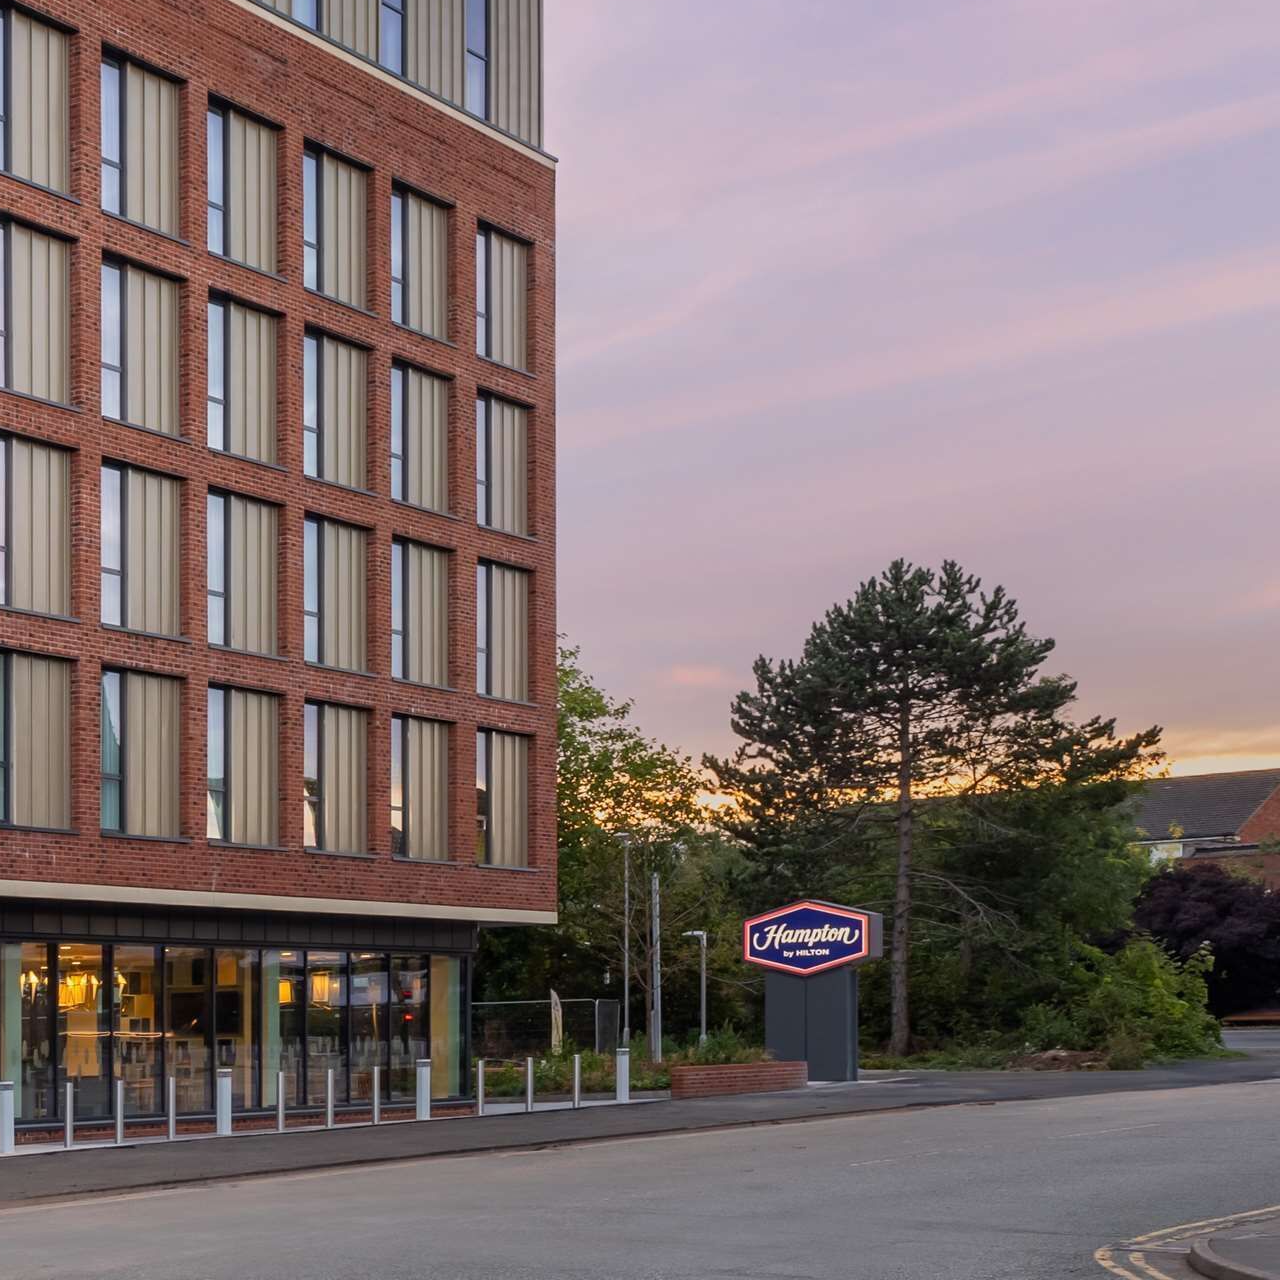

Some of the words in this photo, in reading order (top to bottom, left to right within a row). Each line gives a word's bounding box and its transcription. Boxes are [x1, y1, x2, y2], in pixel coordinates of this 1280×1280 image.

[753, 923, 859, 950] Hampton
[783, 950, 795, 959] by
[796, 948, 830, 957] HILTON
